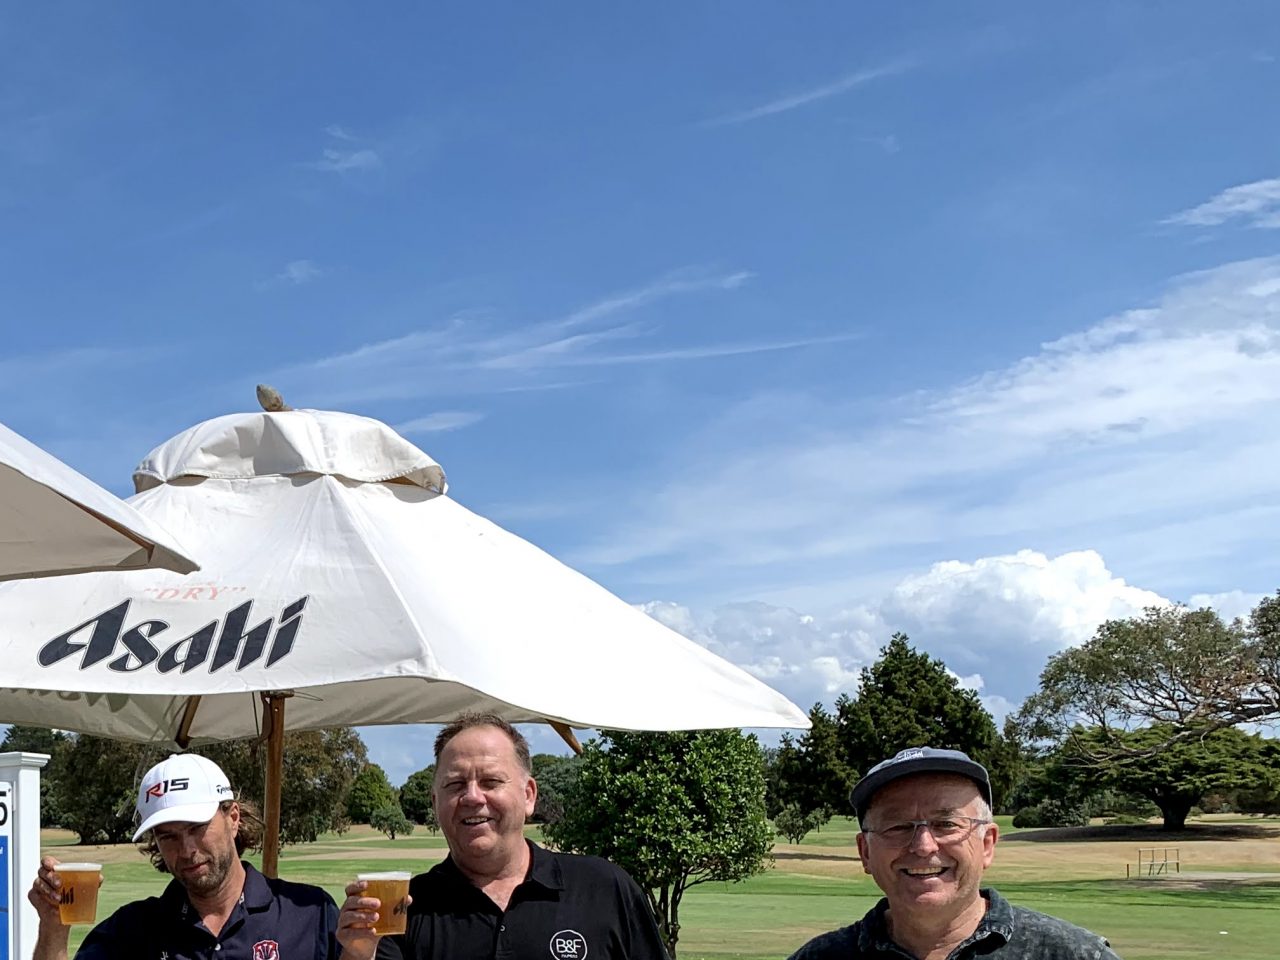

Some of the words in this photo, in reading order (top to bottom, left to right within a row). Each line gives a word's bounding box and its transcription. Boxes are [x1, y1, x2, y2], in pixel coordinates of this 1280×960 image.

[37, 594, 310, 675] Asahi
[145, 778, 190, 803] R15
[556, 938, 583, 955] B&F
